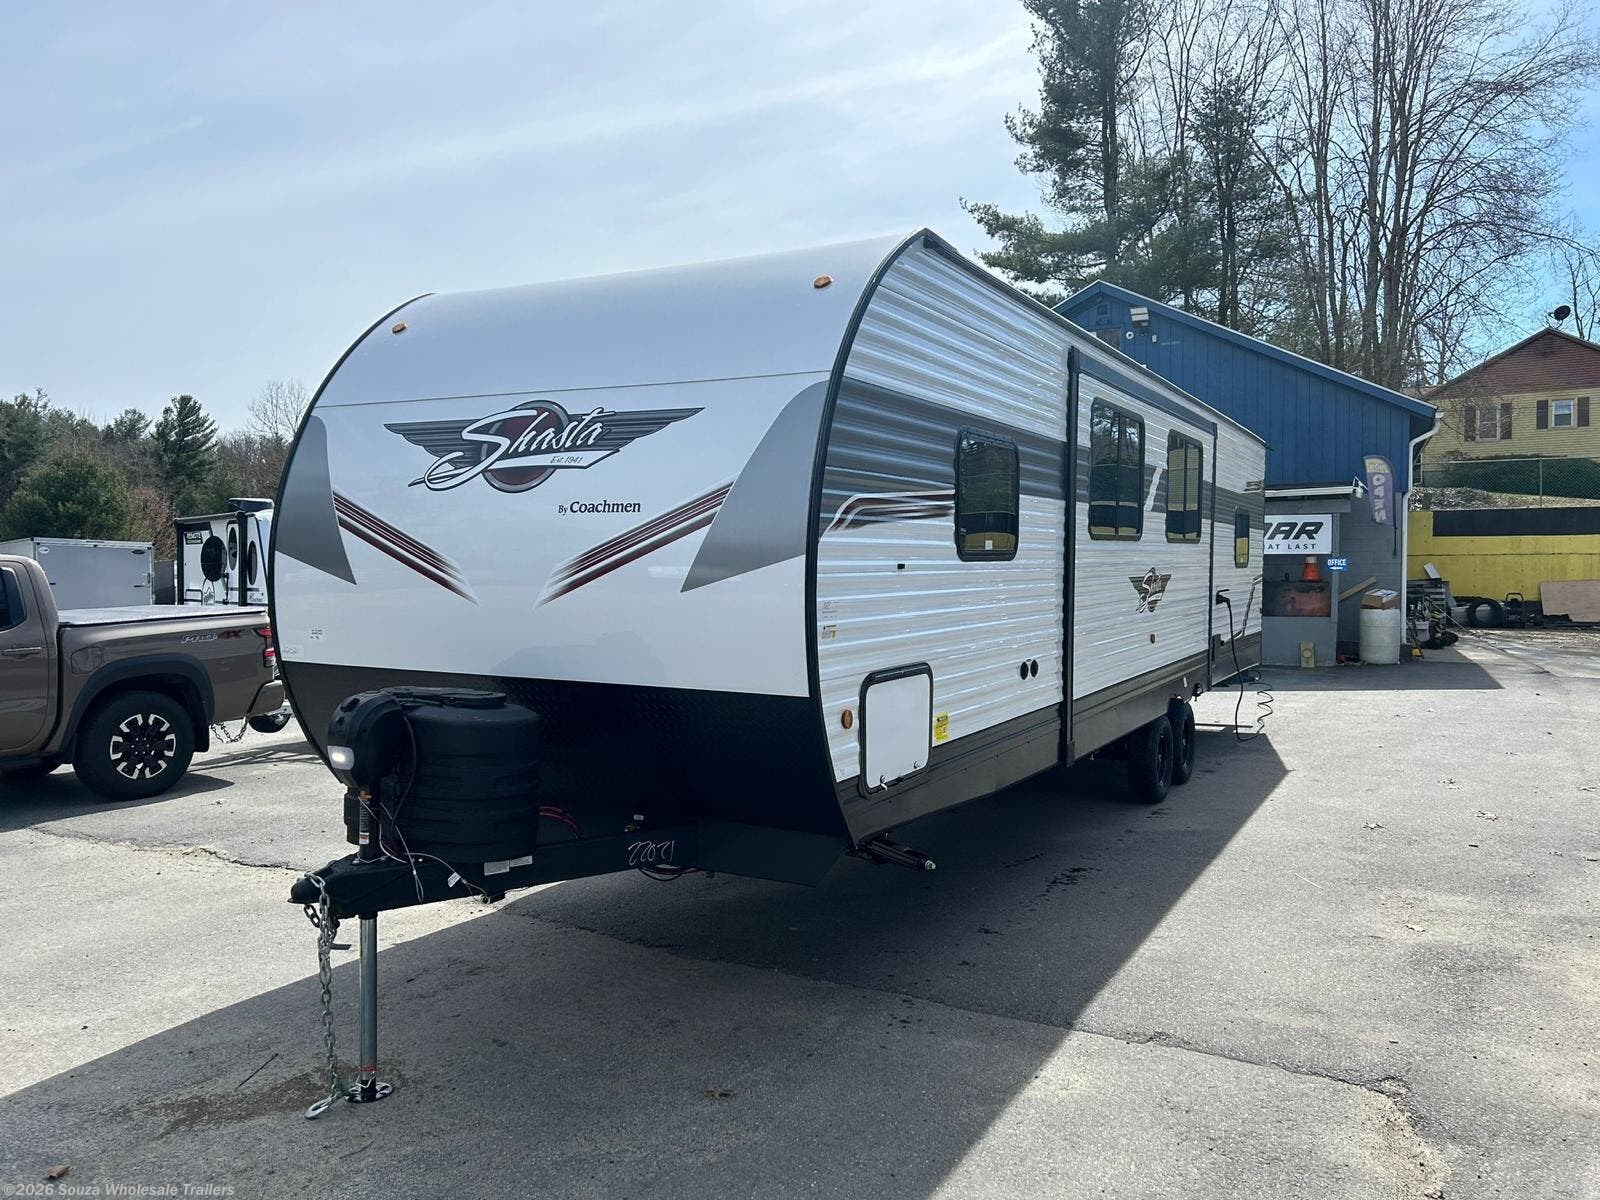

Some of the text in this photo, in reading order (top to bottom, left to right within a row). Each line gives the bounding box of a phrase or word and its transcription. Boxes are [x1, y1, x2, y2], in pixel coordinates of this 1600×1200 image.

[422, 406, 616, 491] Shasta
[564, 456, 583, 464] 1941
[558, 499, 641, 516] By Coachmen
[1268, 543, 1317, 551] AT LAST
[1327, 558, 1347, 567] OFFICE
